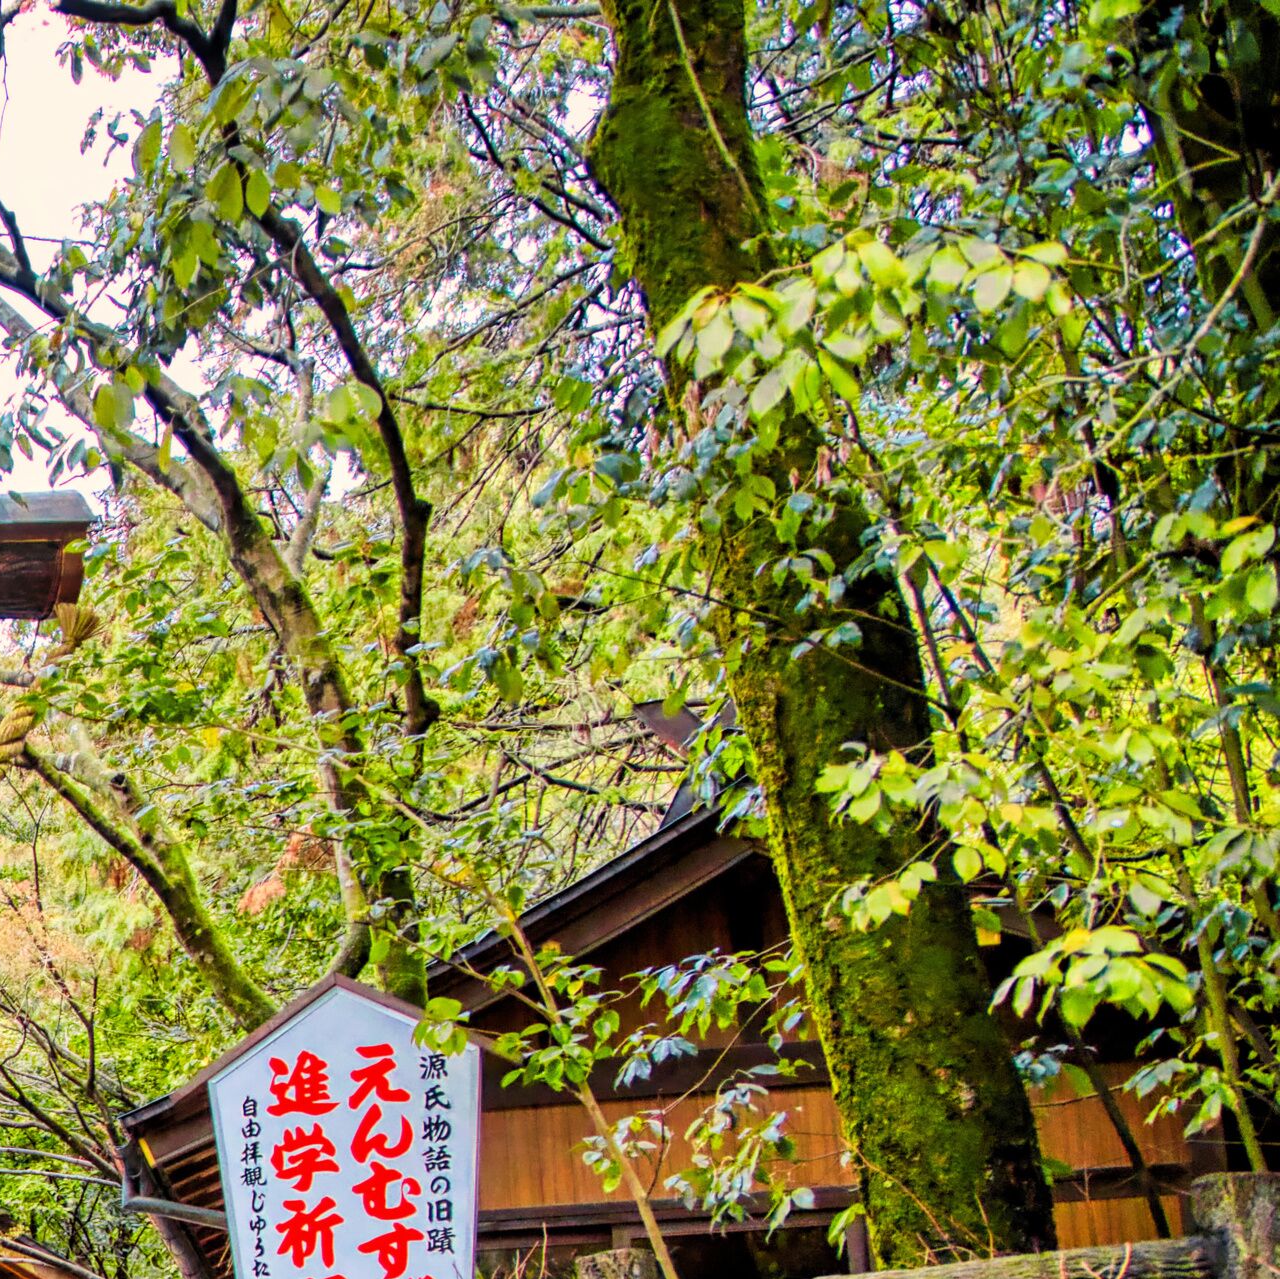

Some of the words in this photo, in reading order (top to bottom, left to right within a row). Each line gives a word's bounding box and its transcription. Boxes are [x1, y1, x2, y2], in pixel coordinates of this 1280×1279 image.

[419, 1053, 457, 1256] 源氏物語の旧蹟
